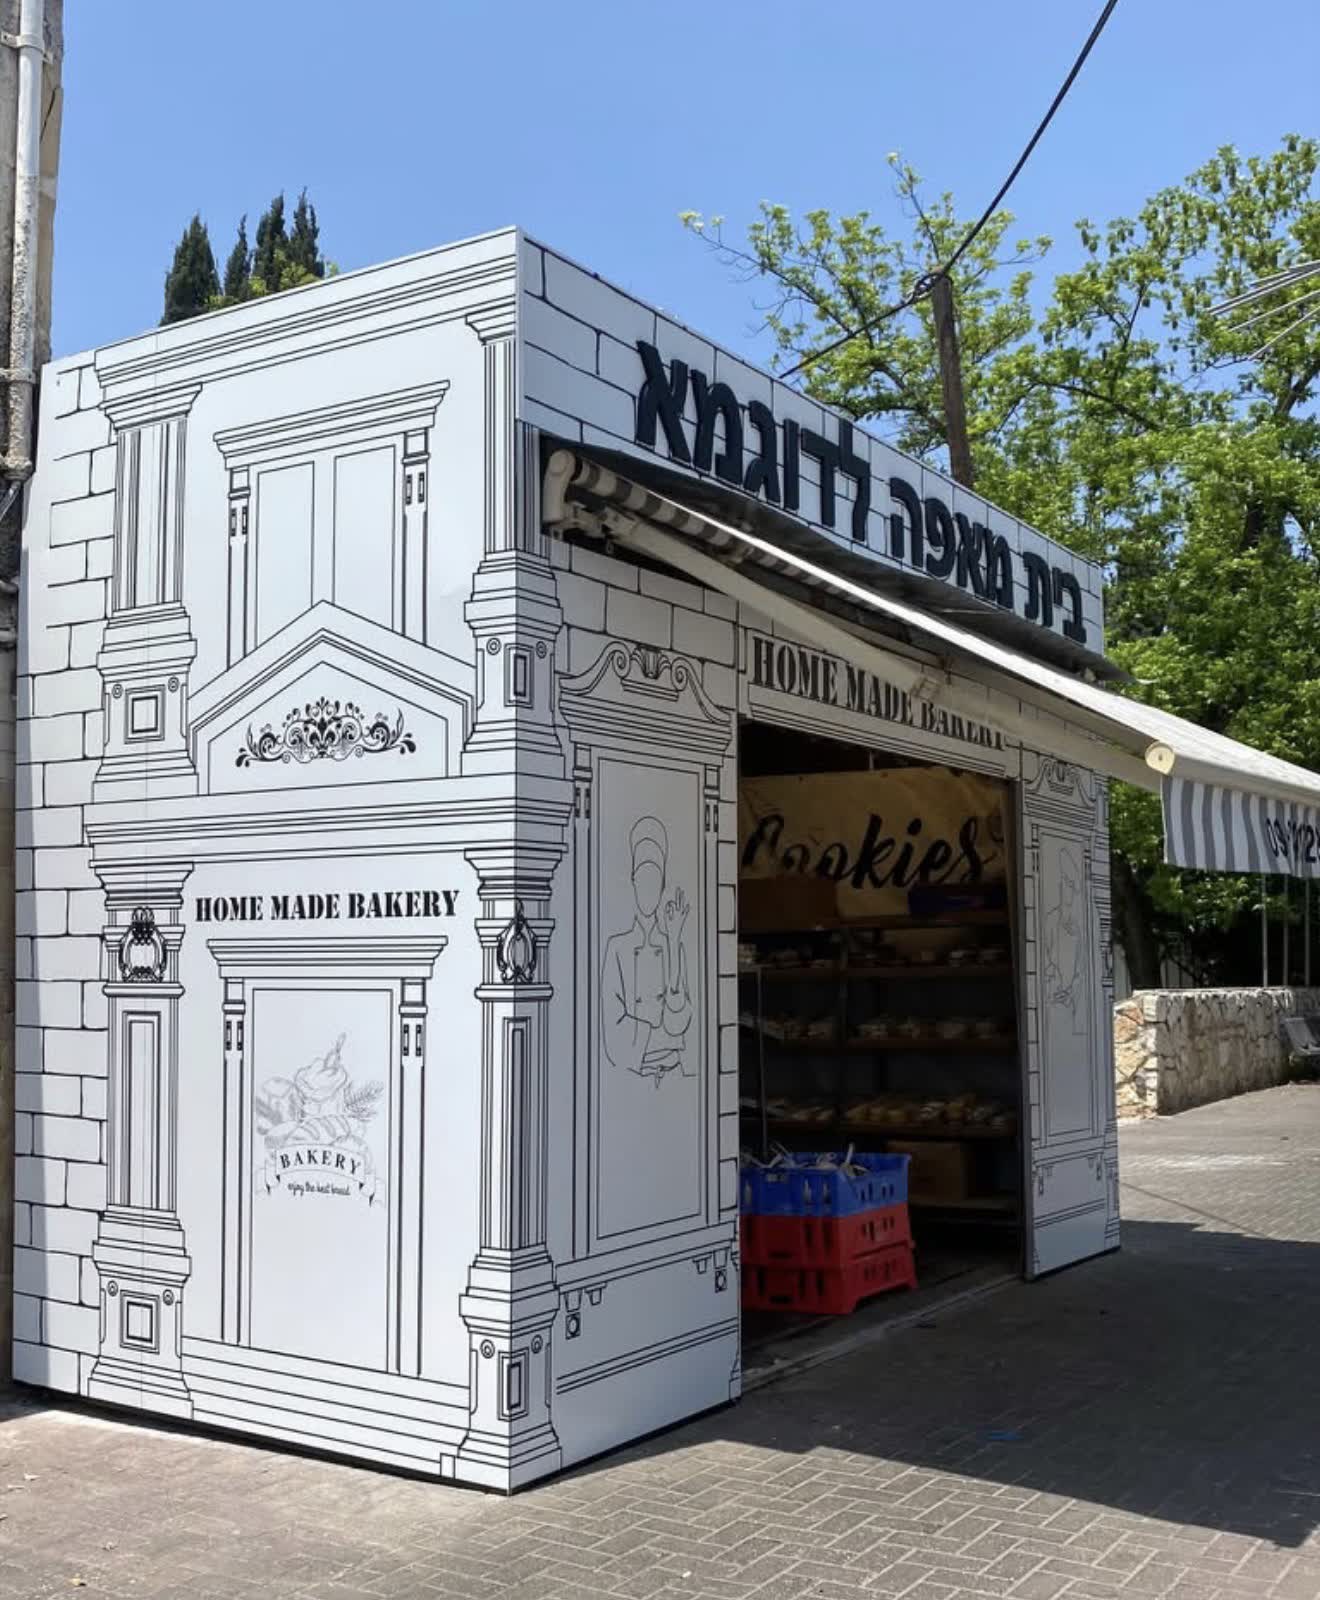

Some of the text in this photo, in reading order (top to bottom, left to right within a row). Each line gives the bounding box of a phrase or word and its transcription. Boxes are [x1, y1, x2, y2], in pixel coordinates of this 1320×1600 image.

[635, 340, 1087, 644] בית מאפה לדוגמא
[751, 636, 838, 705] HOME
[845, 664, 914, 726] MADE
[195, 889, 460, 922] HOME MADE BAKERY
[279, 1149, 361, 1175] BAKERY
